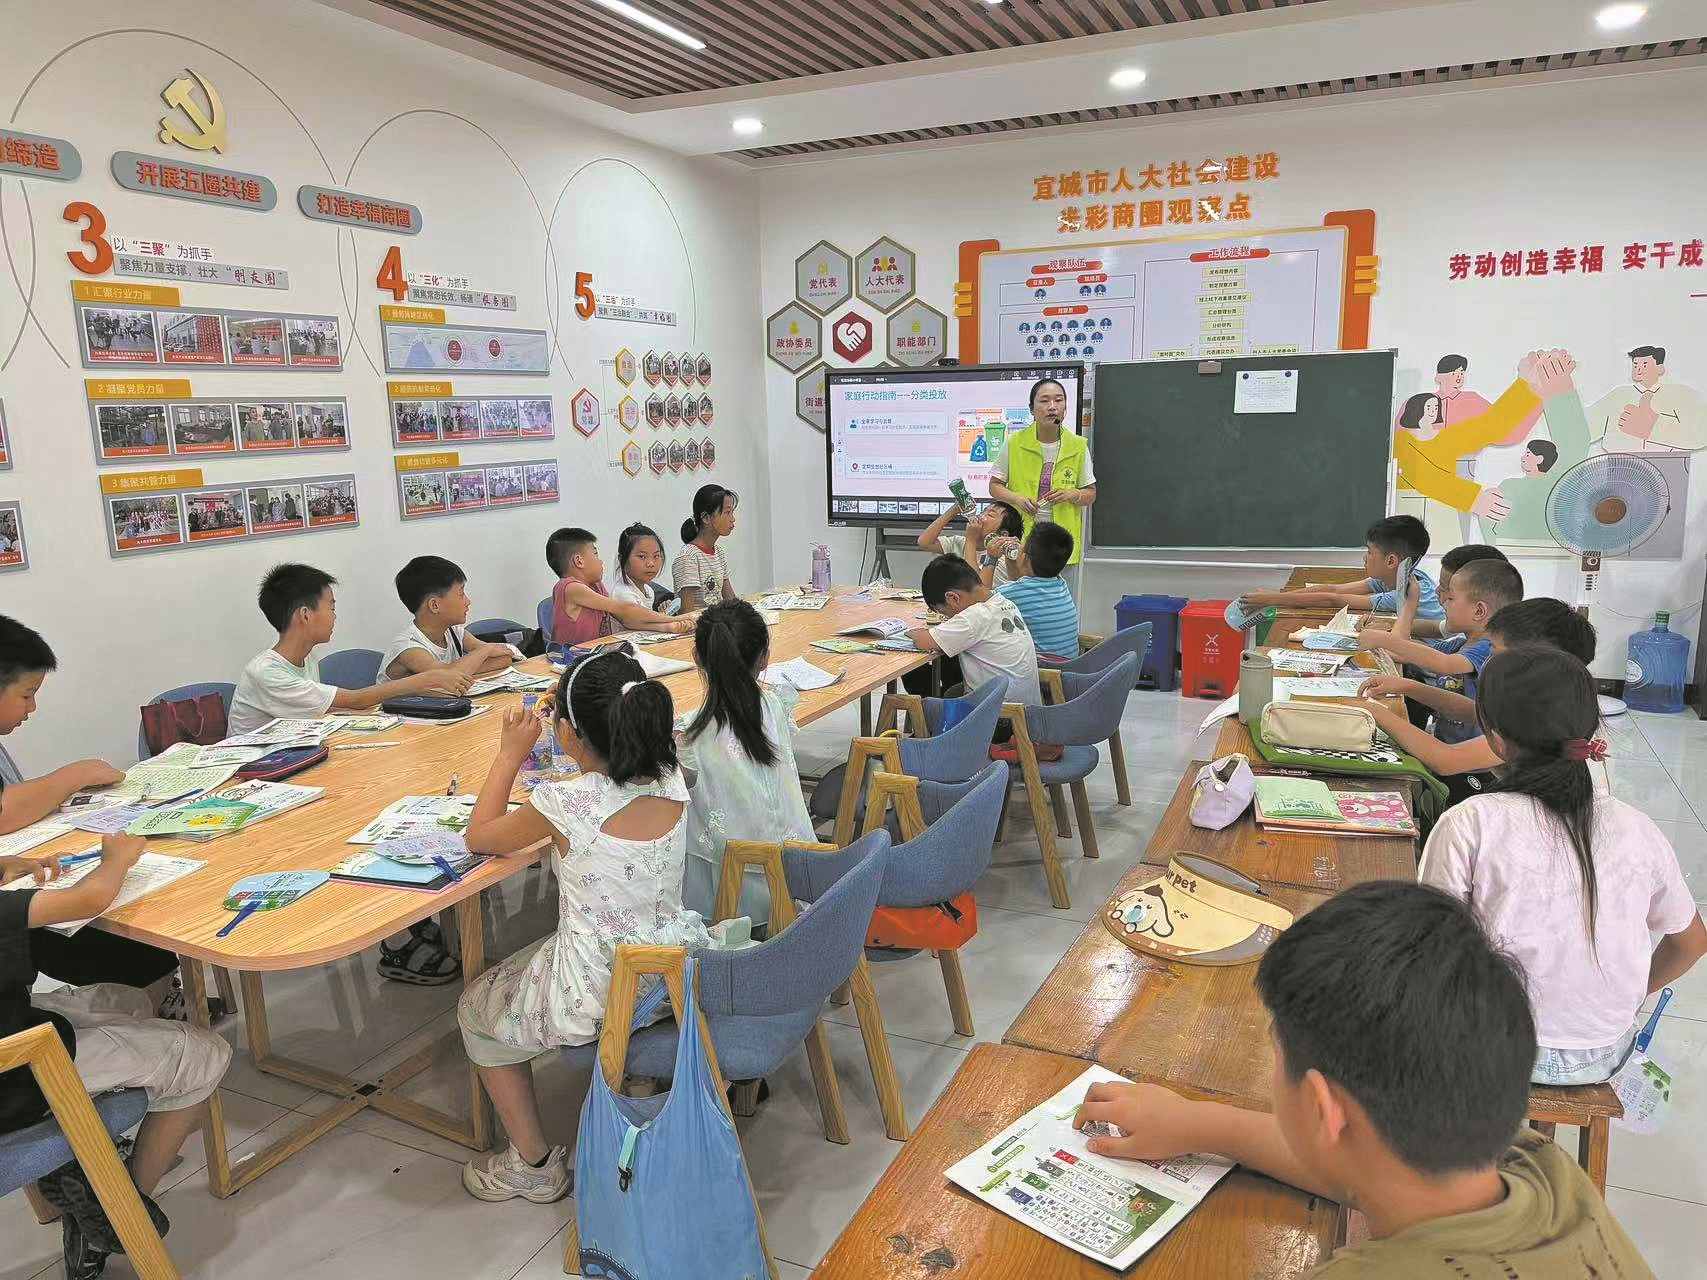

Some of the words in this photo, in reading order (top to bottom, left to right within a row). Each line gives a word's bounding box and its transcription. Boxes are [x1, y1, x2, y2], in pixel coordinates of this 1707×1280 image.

[136, 160, 262, 202] 开展五圈共建
[1034, 152, 1280, 200] 宜城市人大社会建设
[1056, 192, 1251, 233] 光彩商圈观察点
[63, 202, 114, 274] 3
[1209, 246, 1249, 259] 工作流程
[1449, 245, 1605, 279] 劳动创造幸福
[376, 246, 409, 301] 4
[1048, 258, 1087, 271] 观察队伍
[809, 278, 838, 289] 党代表
[866, 274, 905, 287] 人大代表
[575, 271, 596, 318] 5
[776, 338, 813, 348] 政协委员
[896, 336, 936, 347] 职能部门
[805, 397, 825, 407] 街道
[1172, 873, 1197, 893] pet
